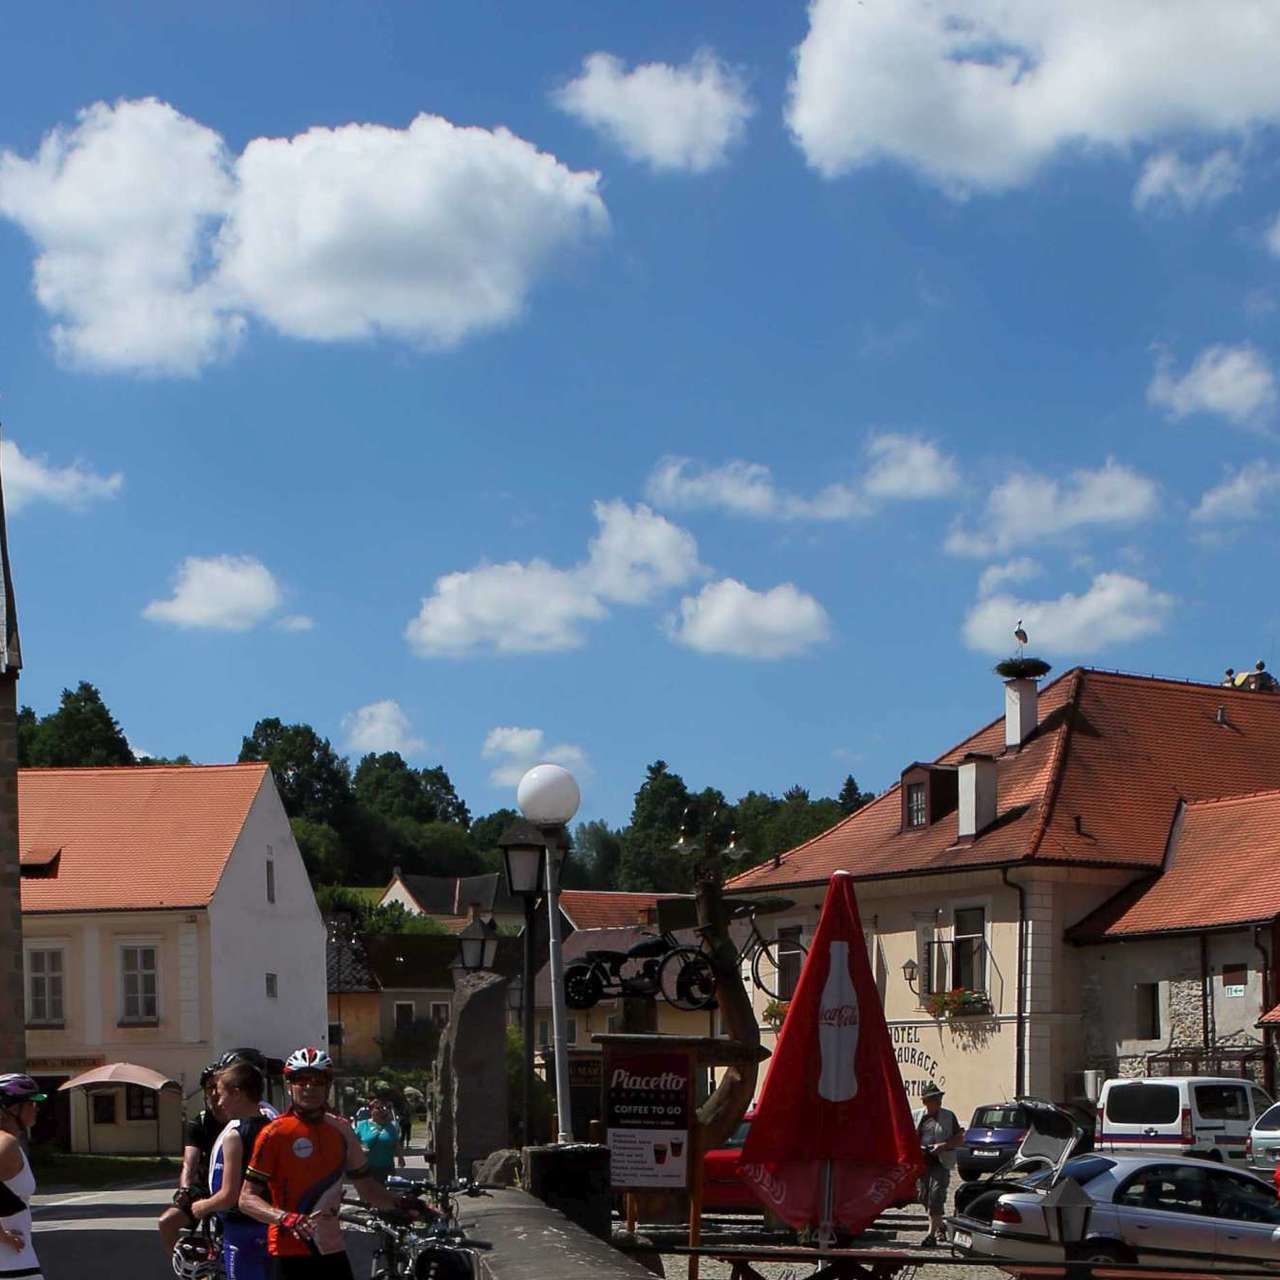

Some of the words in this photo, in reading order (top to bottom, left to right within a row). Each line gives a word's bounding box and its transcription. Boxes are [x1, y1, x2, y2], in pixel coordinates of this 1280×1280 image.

[610, 1068, 687, 1091] Piacetto
[614, 1104, 649, 1114] COFFEE
[651, 1105, 665, 1115] TO
[667, 1106, 682, 1116] GO
